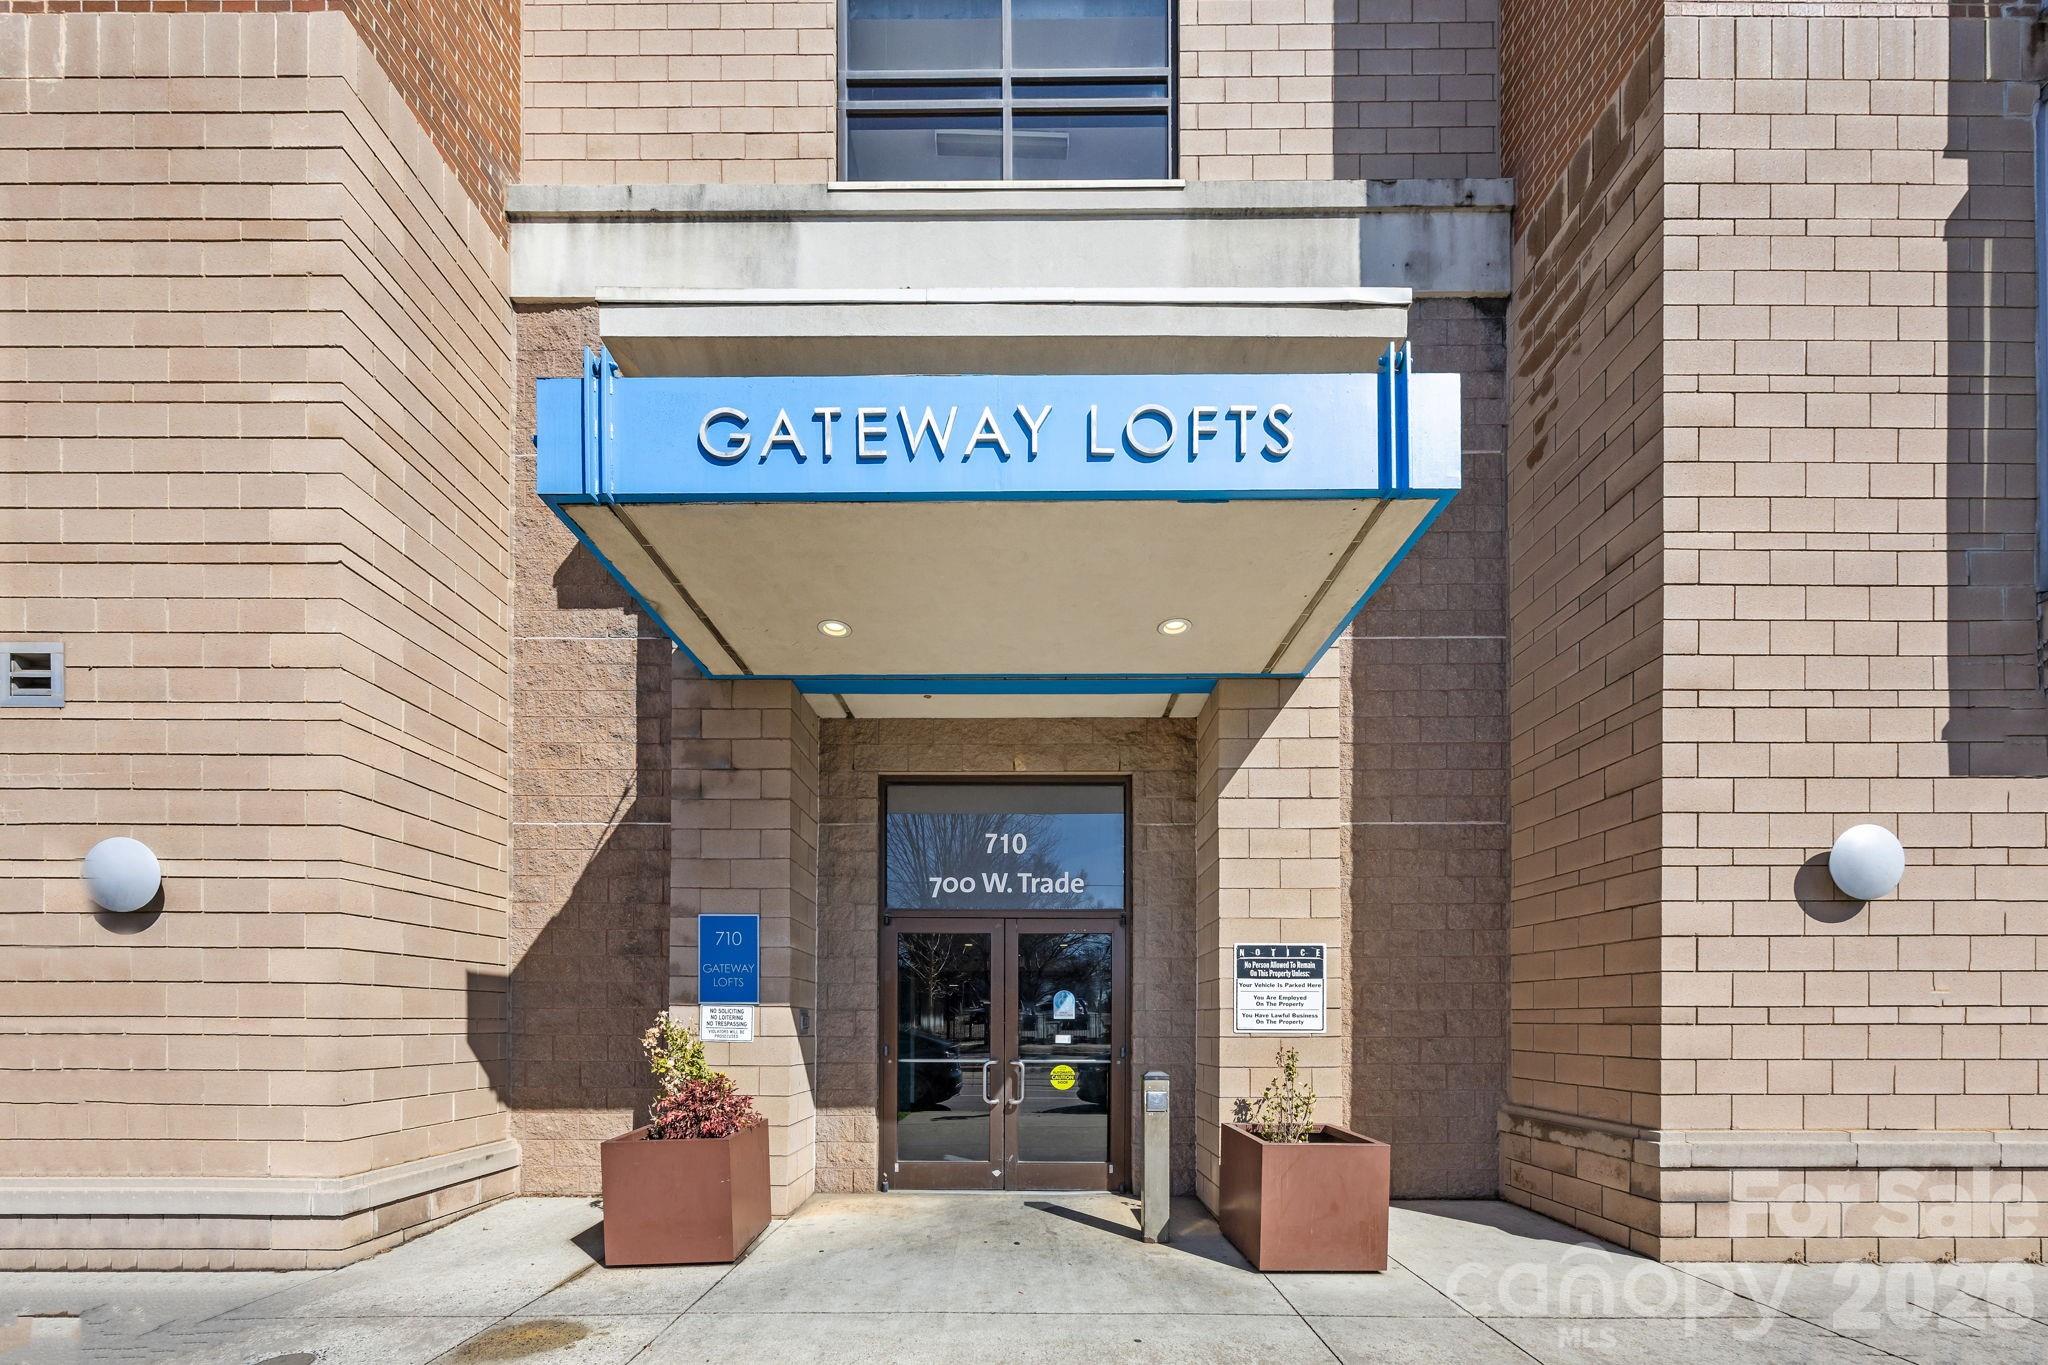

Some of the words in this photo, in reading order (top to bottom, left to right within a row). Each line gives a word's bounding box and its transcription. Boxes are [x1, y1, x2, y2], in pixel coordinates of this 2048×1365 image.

[697, 404, 1052, 466] GATEWAY
[1087, 403, 1294, 464] LOFTS
[985, 833, 1028, 855] 710
[929, 877, 976, 899] 700
[982, 873, 1013, 894] W.
[1017, 872, 1085, 894] Trade
[715, 931, 743, 946] 710
[702, 963, 755, 974] GATEWAY
[1244, 961, 1251, 969] No
[1252, 961, 1270, 969] Person
[1270, 961, 1289, 969] Allowed
[1290, 961, 1296, 969] To
[1297, 961, 1316, 969] Remain
[1249, 969, 1257, 977] On
[1257, 969, 1268, 977] This
[1269, 969, 1291, 978] Property
[713, 977, 744, 988] LOFTS
[715, 1020, 748, 1028] TRESPASSING
